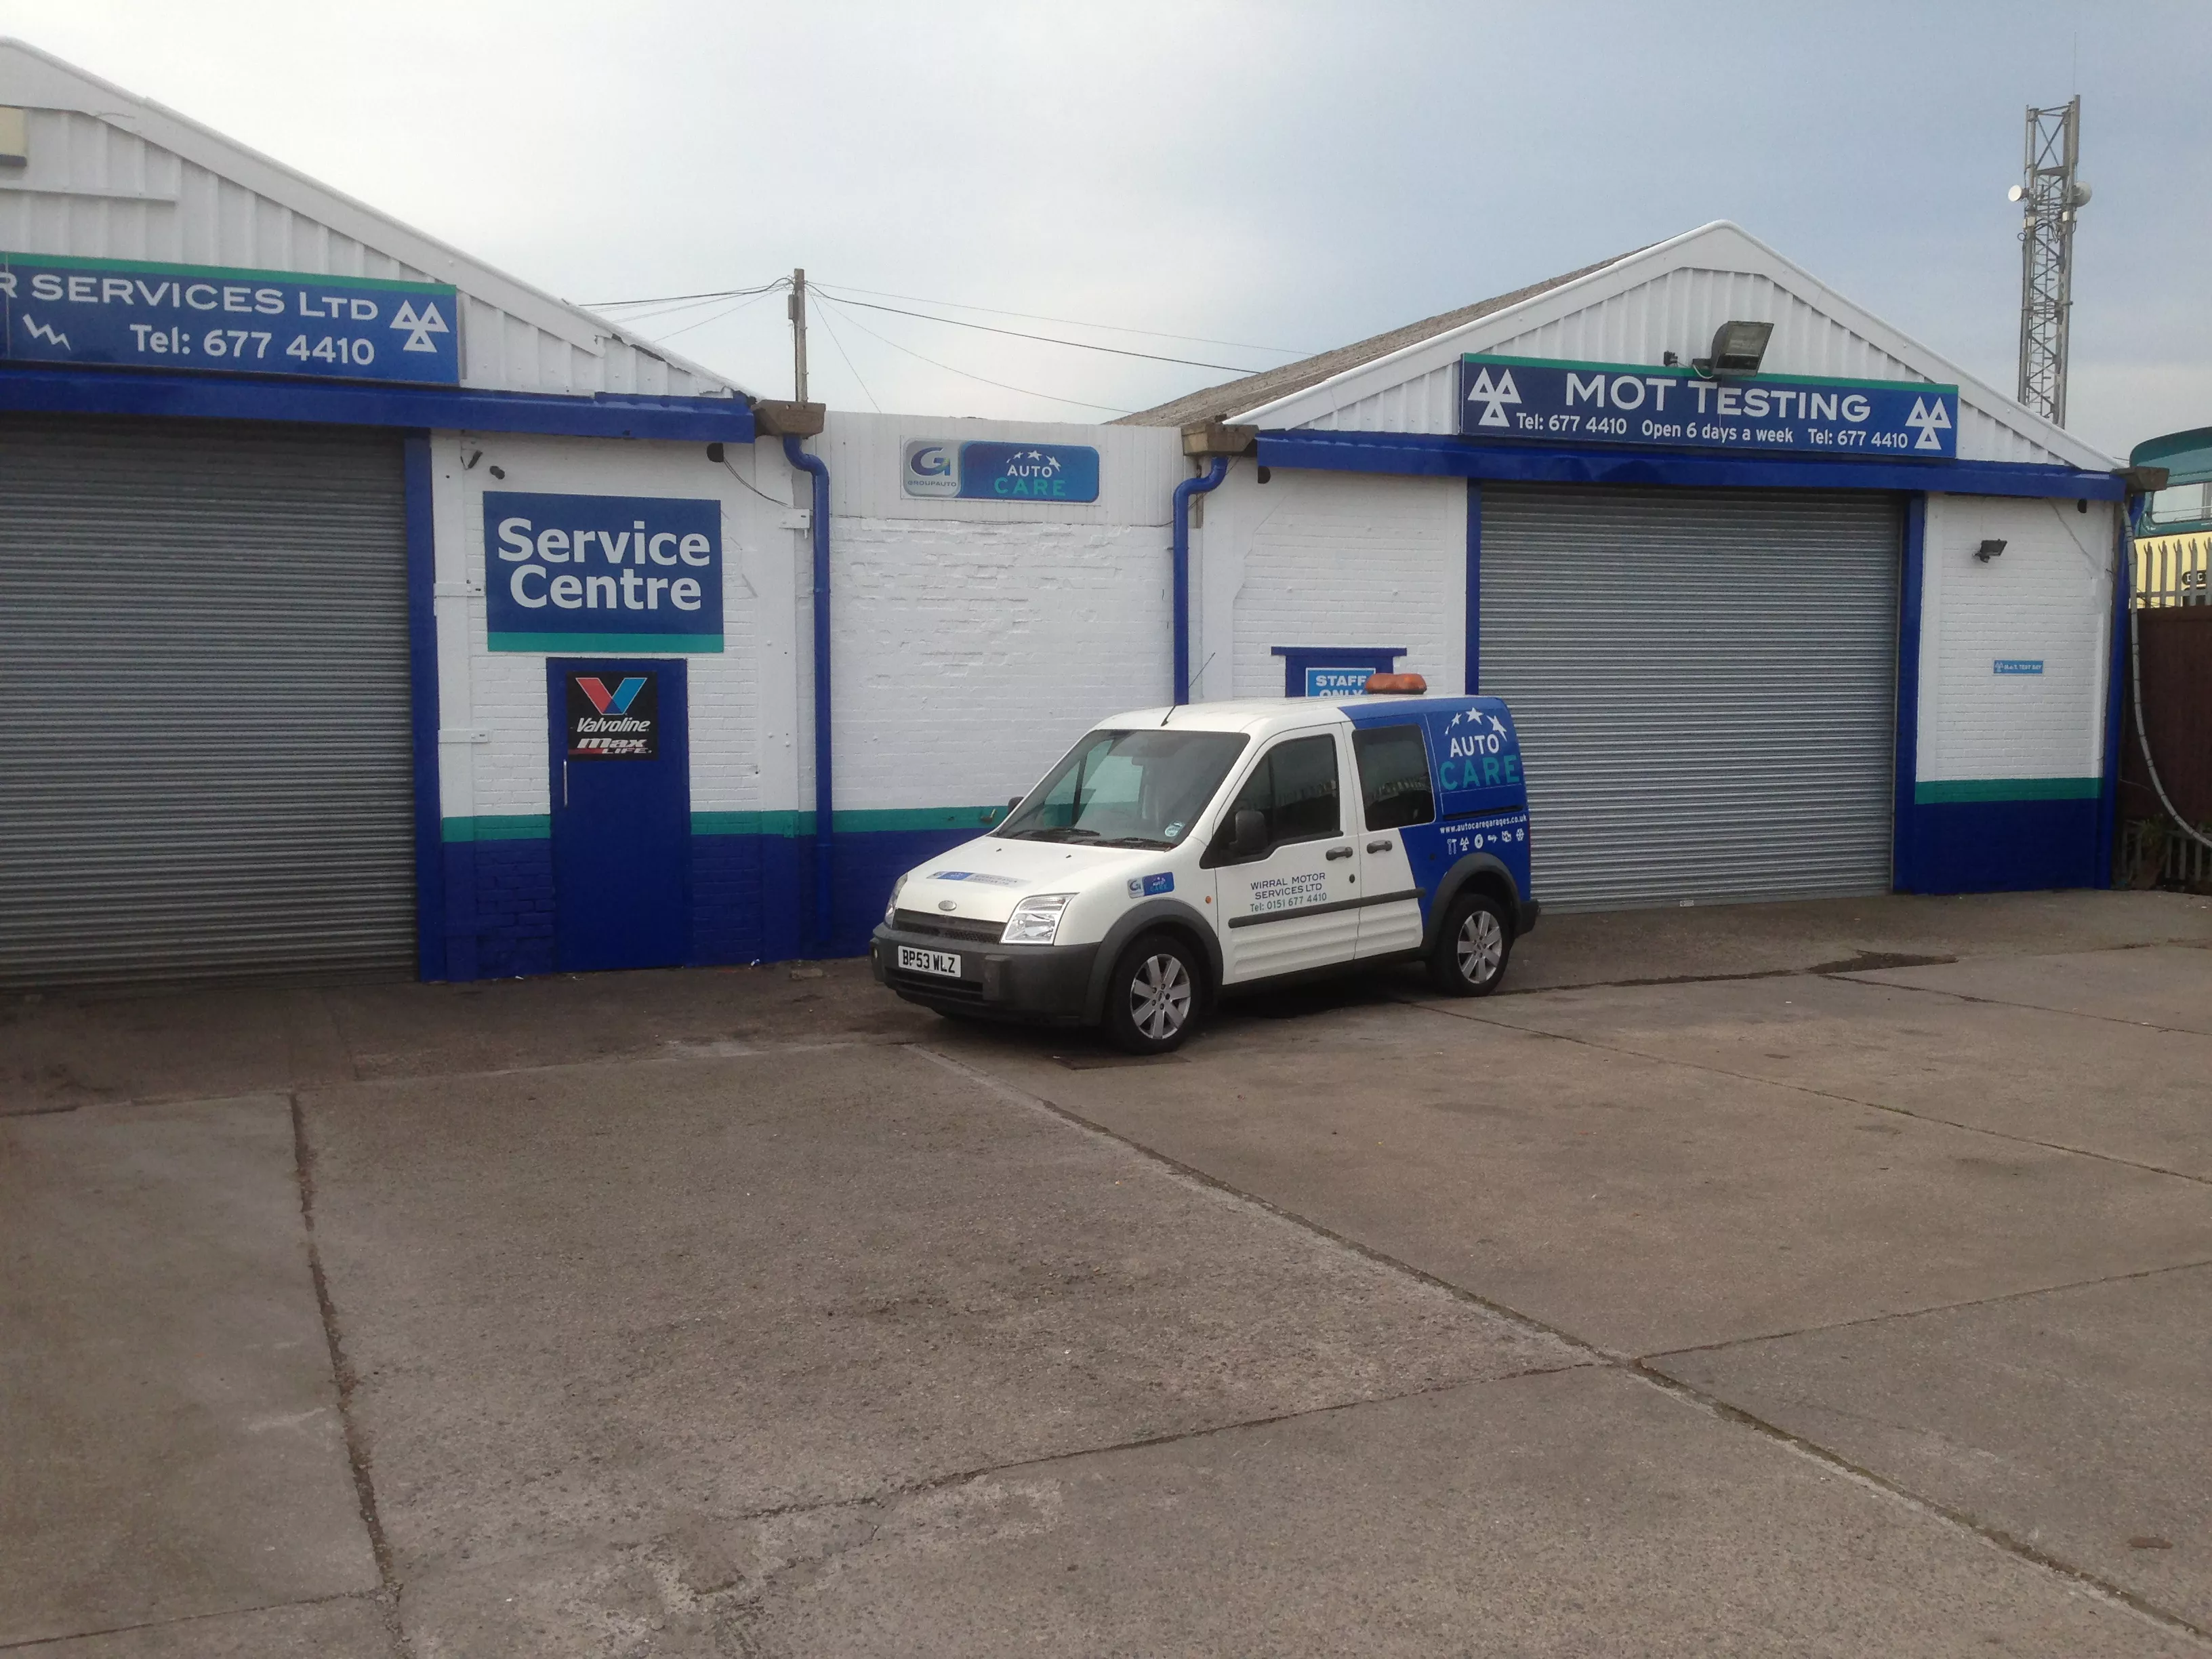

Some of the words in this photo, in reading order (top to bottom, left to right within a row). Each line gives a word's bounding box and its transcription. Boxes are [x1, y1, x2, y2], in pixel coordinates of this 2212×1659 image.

[31, 274, 286, 314] SERVICES
[298, 291, 378, 320] LTD
[129, 324, 190, 353] Tel:
[203, 330, 271, 359] 677
[286, 336, 375, 365] 4410
[1565, 373, 1677, 411] MOT
[1687, 380, 1870, 422] TESTING
[1516, 412, 1543, 430] Tel:
[1549, 415, 1580, 432] 677
[1586, 417, 1626, 434] 4410
[1642, 419, 1681, 439] Open
[1686, 422, 1697, 438] 6
[1702, 424, 1736, 443] days
[1742, 428, 1750, 441] a
[1756, 427, 1793, 443] week
[1808, 428, 1832, 445] Tel:
[1837, 430, 1866, 447] 677
[1871, 432, 1908, 449] 4410
[1007, 464, 1052, 478] AUTO
[994, 476, 1066, 496] CARE
[497, 517, 710, 567] Service
[510, 564, 701, 611] Centre
[1315, 675, 1366, 687] STAFF
[577, 717, 651, 732] Valvoline
[1450, 733, 1500, 758] AUTO
[1440, 755, 1520, 790] CARE
[1440, 815, 1527, 834] www.autocaregarages.co.uk
[1250, 878, 1288, 890] WIRRAL
[1292, 873, 1326, 884] MOTOR
[1255, 887, 1304, 900] SERVICES
[1306, 883, 1322, 892] LTD
[1250, 903, 1265, 912] Tel:
[1267, 900, 1286, 910] 0151
[1288, 896, 1303, 907] 677
[1307, 893, 1327, 903] 4410
[903, 949, 930, 969] BP53
[933, 954, 956, 974] WLZ
